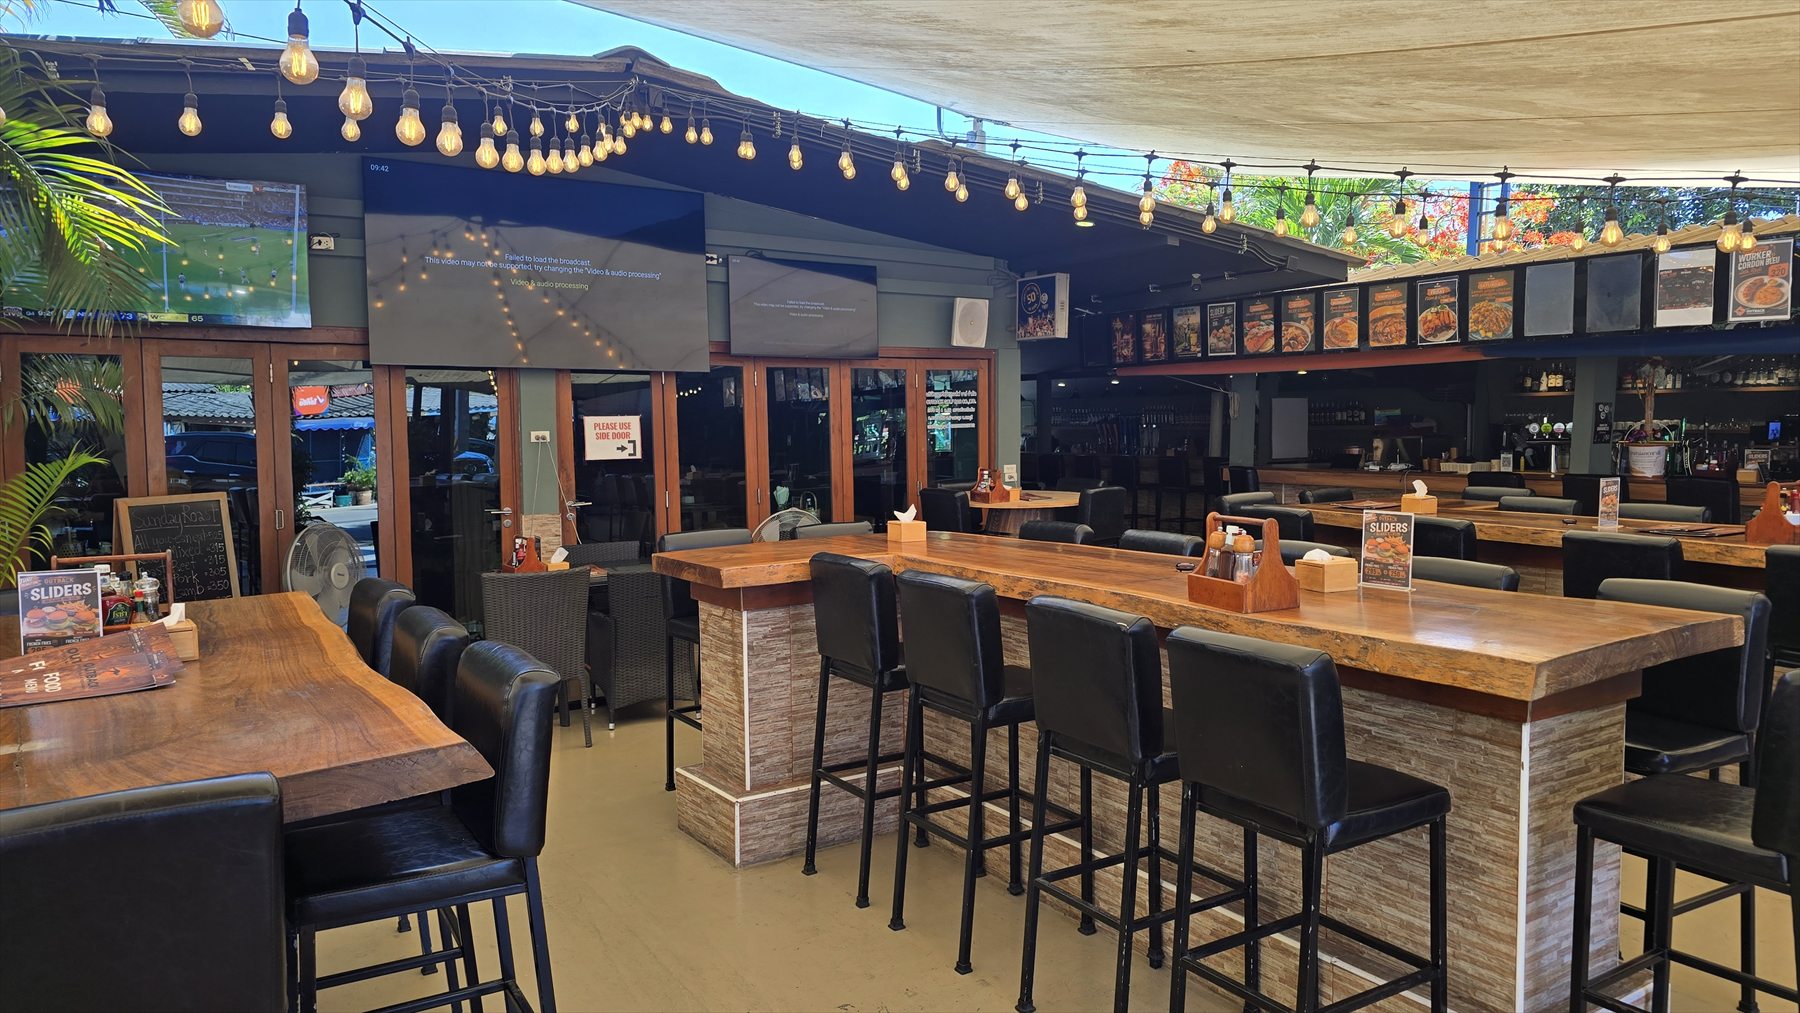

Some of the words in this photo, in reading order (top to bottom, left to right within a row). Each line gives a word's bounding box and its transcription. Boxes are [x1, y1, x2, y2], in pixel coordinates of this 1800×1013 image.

[370, 164, 389, 172] 09:42
[505, 253, 524, 262] Failed
[533, 255, 547, 263] load
[548, 256, 559, 264] the
[425, 256, 440, 264] This
[440, 257, 459, 266] video
[460, 259, 475, 267] may
[476, 259, 488, 267] not
[534, 264, 543, 272] try
[543, 264, 573, 274] changing
[573, 266, 584, 274] the
[611, 269, 627, 277] audio
[1737, 259, 1764, 270] CORDON
[537, 280, 554, 288] audio
[555, 281, 589, 290] processing
[594, 422, 617, 430] PLEASE
[619, 422, 631, 430] USE
[595, 432, 610, 440] SIDE
[612, 432, 631, 440] DOOR
[132, 505, 183, 534] Sunday
[182, 504, 220, 523] Roast
[1369, 522, 1408, 533] SLIDERS
[134, 533, 149, 550] All
[30, 582, 92, 601] SLIDERS
[24, 678, 39, 694] MENU
[43, 671, 62, 693] FOOD
